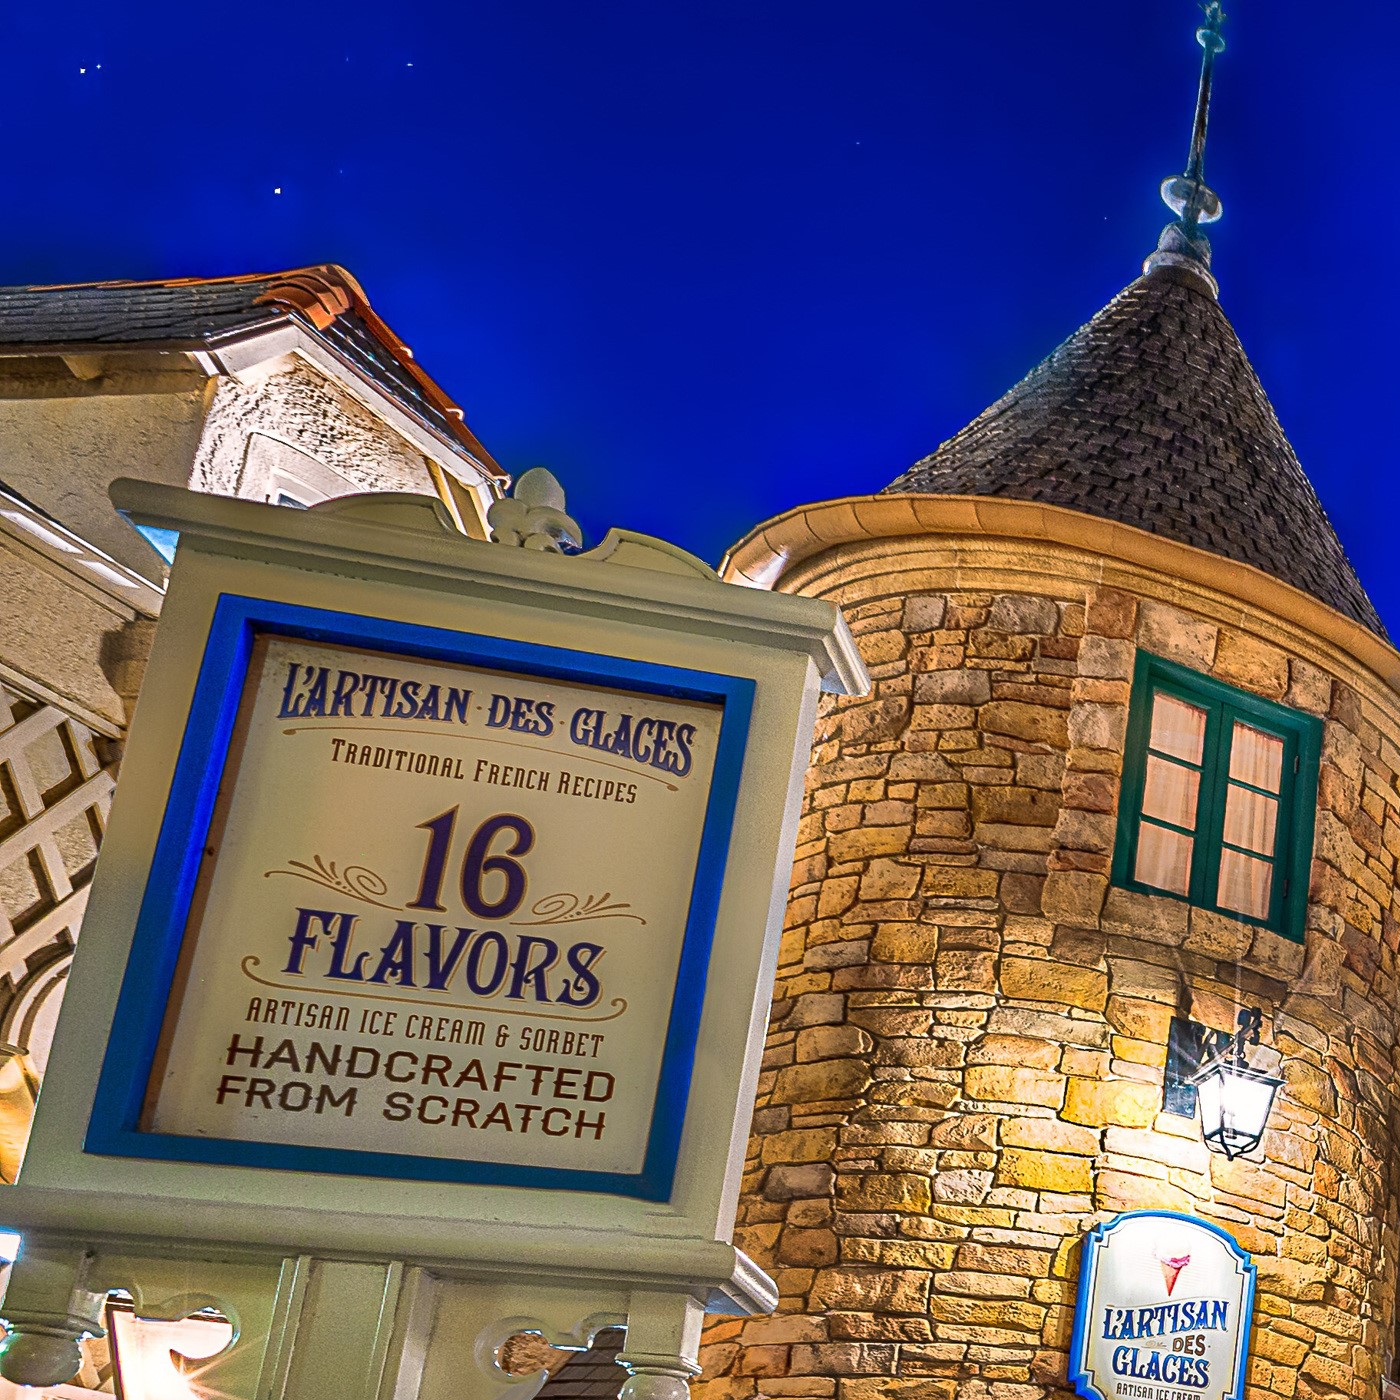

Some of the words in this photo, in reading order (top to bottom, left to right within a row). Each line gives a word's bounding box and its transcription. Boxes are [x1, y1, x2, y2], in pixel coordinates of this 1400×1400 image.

[276, 661, 474, 726] L'ARTISAN
[484, 693, 556, 737] DES
[569, 706, 698, 778] GLACES
[331, 737, 465, 780] TRADITIONAL
[473, 758, 551, 792] FRENCH
[557, 770, 638, 804] RECIPES
[405, 803, 537, 921] 16
[280, 906, 608, 1007] FLAVORS
[245, 996, 350, 1032] ARTISAN
[358, 1008, 398, 1037] ICE
[404, 1013, 486, 1047] CREAM
[495, 1023, 510, 1048] &
[518, 1025, 605, 1059] SORBET
[225, 1032, 617, 1104] HANDCRAFTED
[215, 1073, 359, 1118] FROM
[382, 1090, 607, 1141] SCRATCH
[1101, 1299, 1231, 1341] L'ARTISAN
[1172, 1333, 1207, 1357] DES
[1111, 1344, 1212, 1390] GLACES
[1115, 1382, 1154, 1400] ARTISAN
